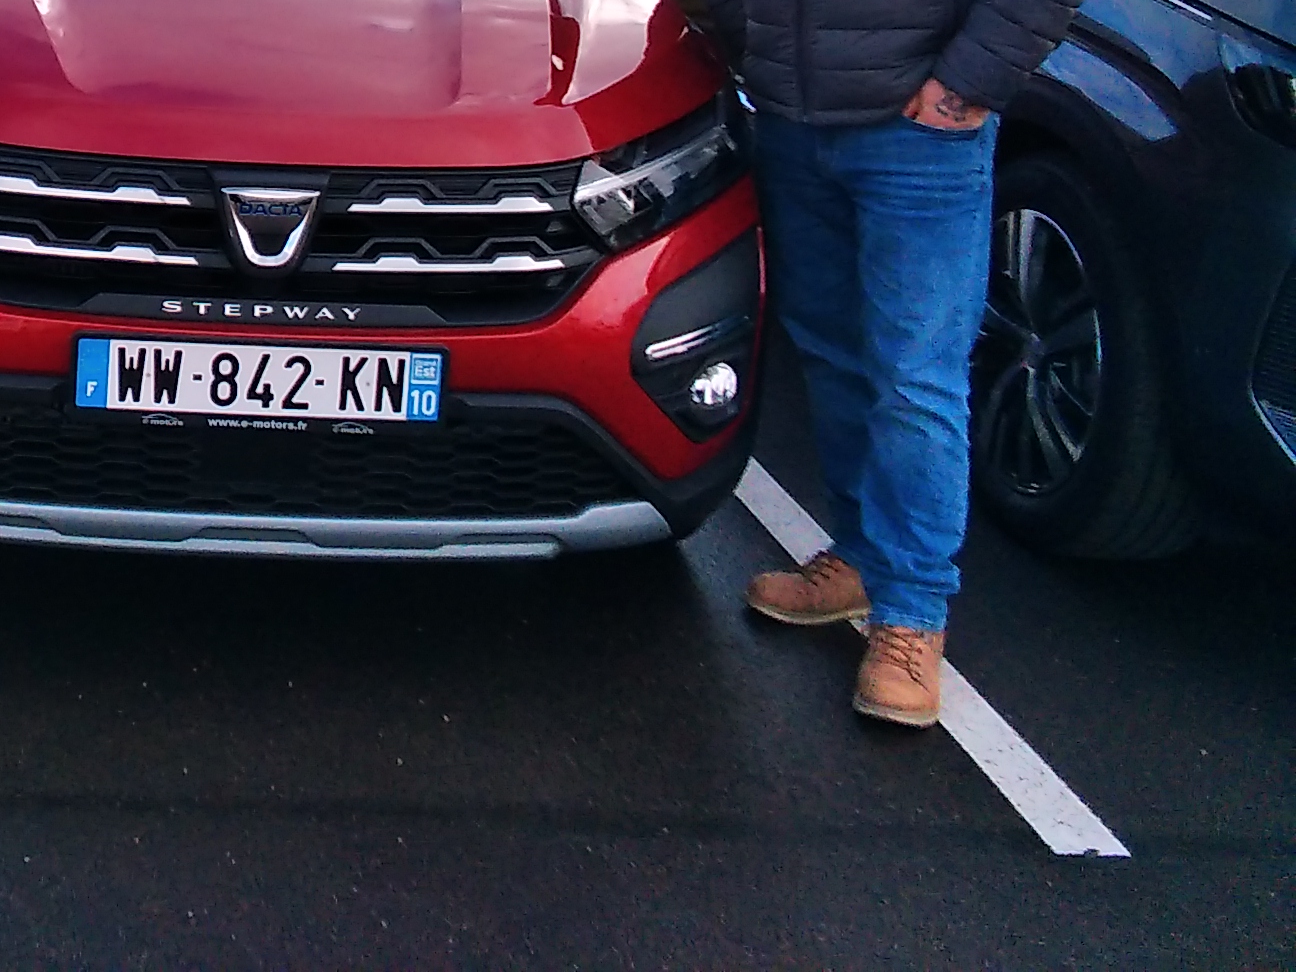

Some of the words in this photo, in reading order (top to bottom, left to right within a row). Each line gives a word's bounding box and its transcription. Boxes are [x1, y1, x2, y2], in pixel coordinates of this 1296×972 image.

[238, 203, 303, 216] DACIA
[161, 300, 362, 322] STEPWAY
[86, 380, 98, 397] F
[410, 389, 437, 417] 10
[207, 416, 308, 431] www.e-motors.fr
